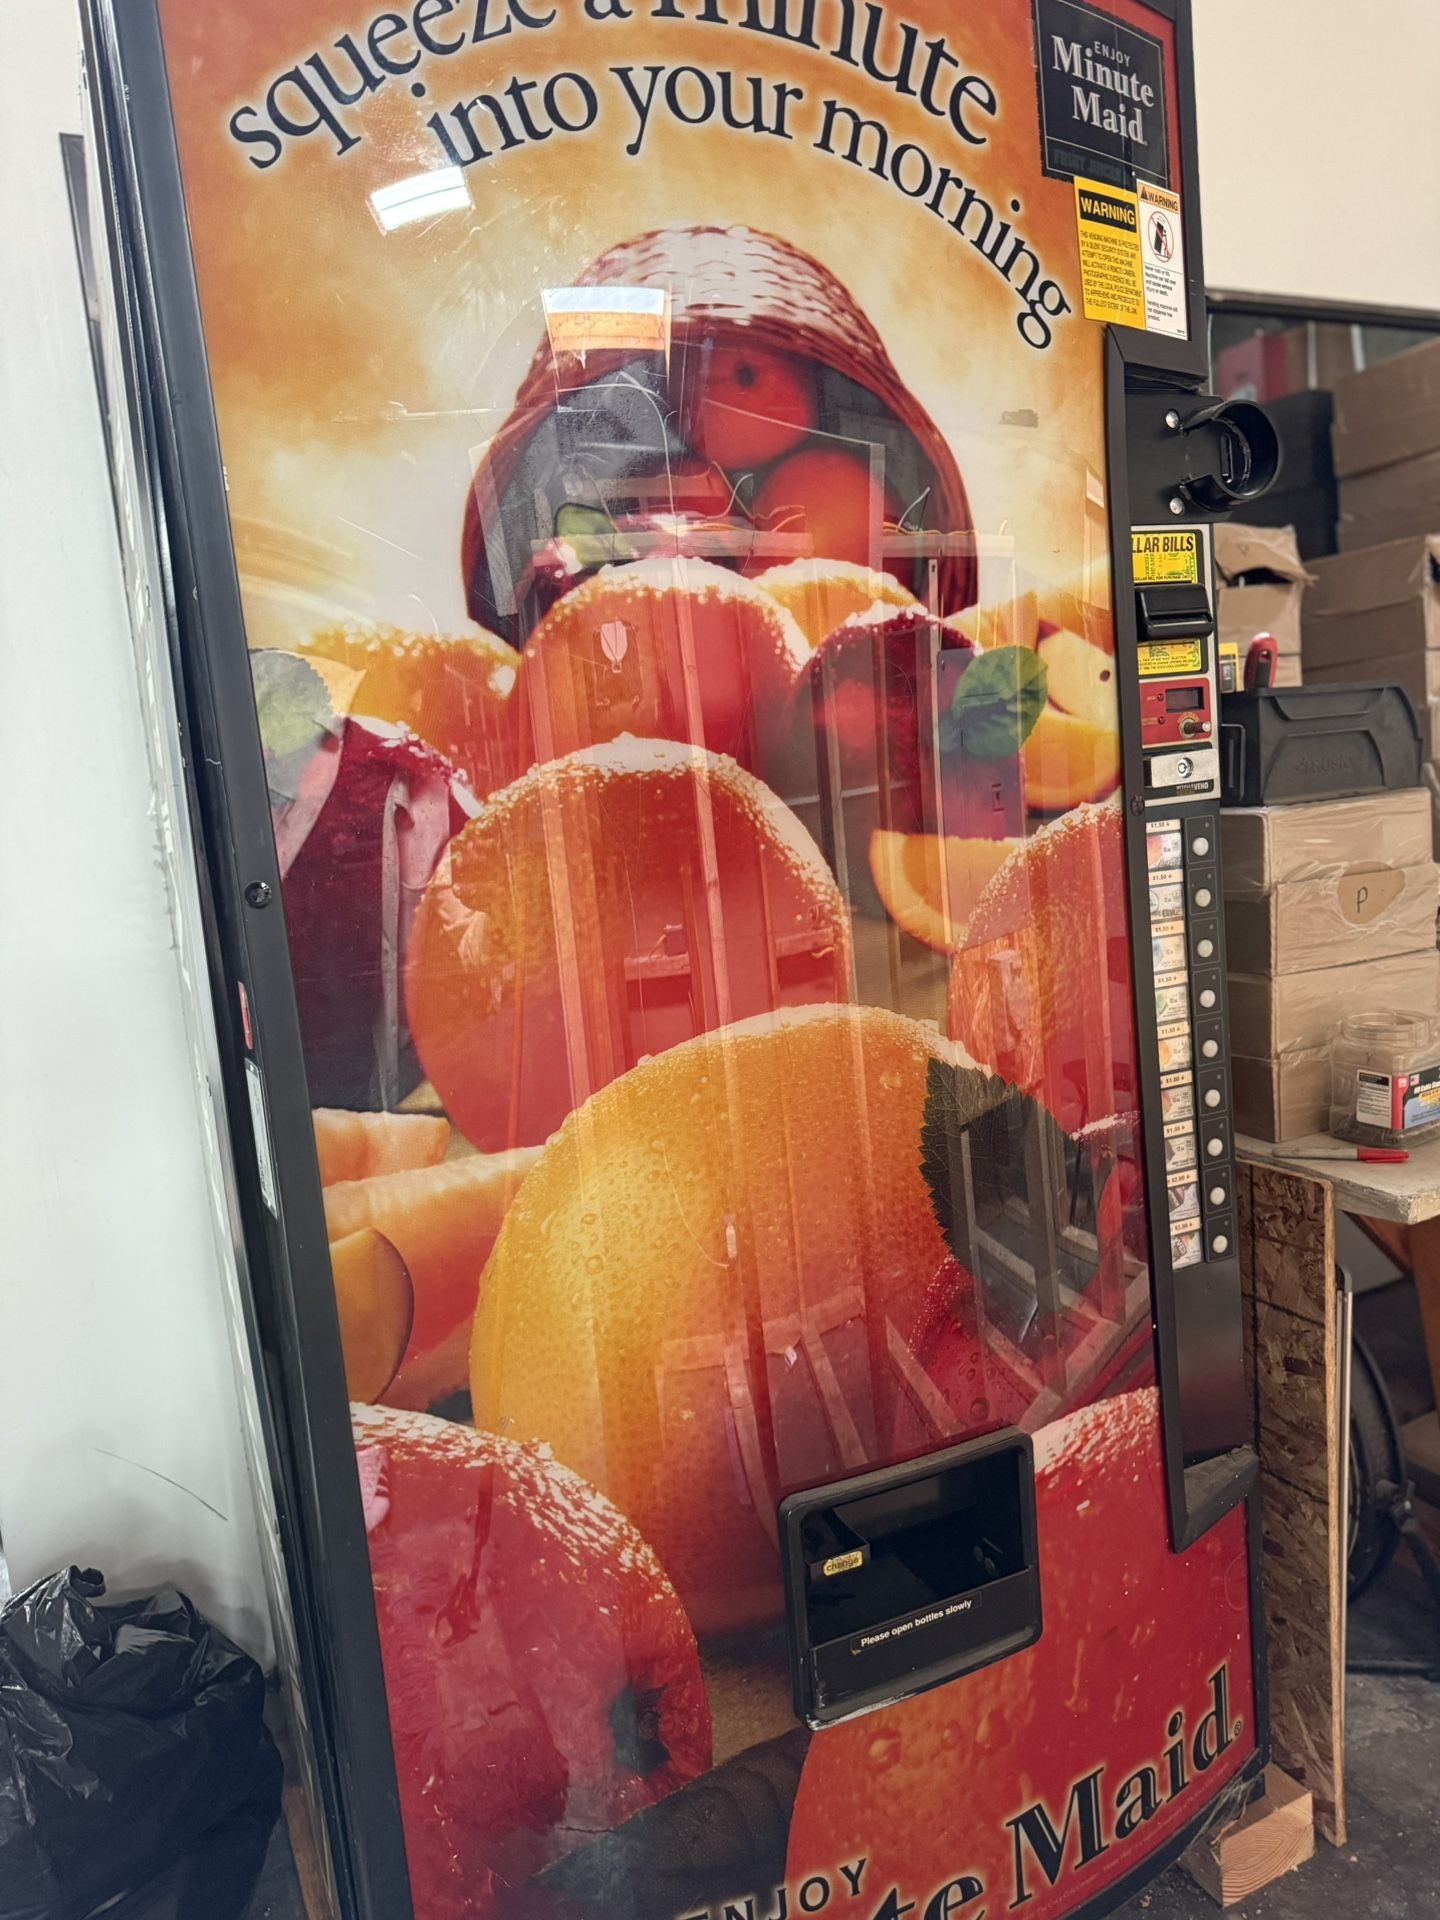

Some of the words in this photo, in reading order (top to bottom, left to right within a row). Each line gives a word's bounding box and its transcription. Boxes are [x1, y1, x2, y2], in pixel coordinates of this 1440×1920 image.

[1051, 35, 1155, 107] Minute
[1094, 41, 1130, 67] ENJOY
[1071, 85, 1146, 145] Maid
[411, 72, 597, 167] into
[609, 66, 803, 155] your
[814, 100, 1072, 349] morning
[1080, 196, 1135, 225] WARNING
[1148, 192, 1178, 212] WARNING
[1162, 536, 1194, 552] BILLS
[1356, 886, 1368, 914] P
[826, 1556, 860, 1573] change
[861, 1631, 890, 1647] Please
[892, 1622, 913, 1637] open
[915, 1610, 944, 1627] bottles
[946, 1599, 972, 1617] slowly
[1006, 1664, 1234, 1909] Maid
[681, 1858, 867, 1920] NJOY
